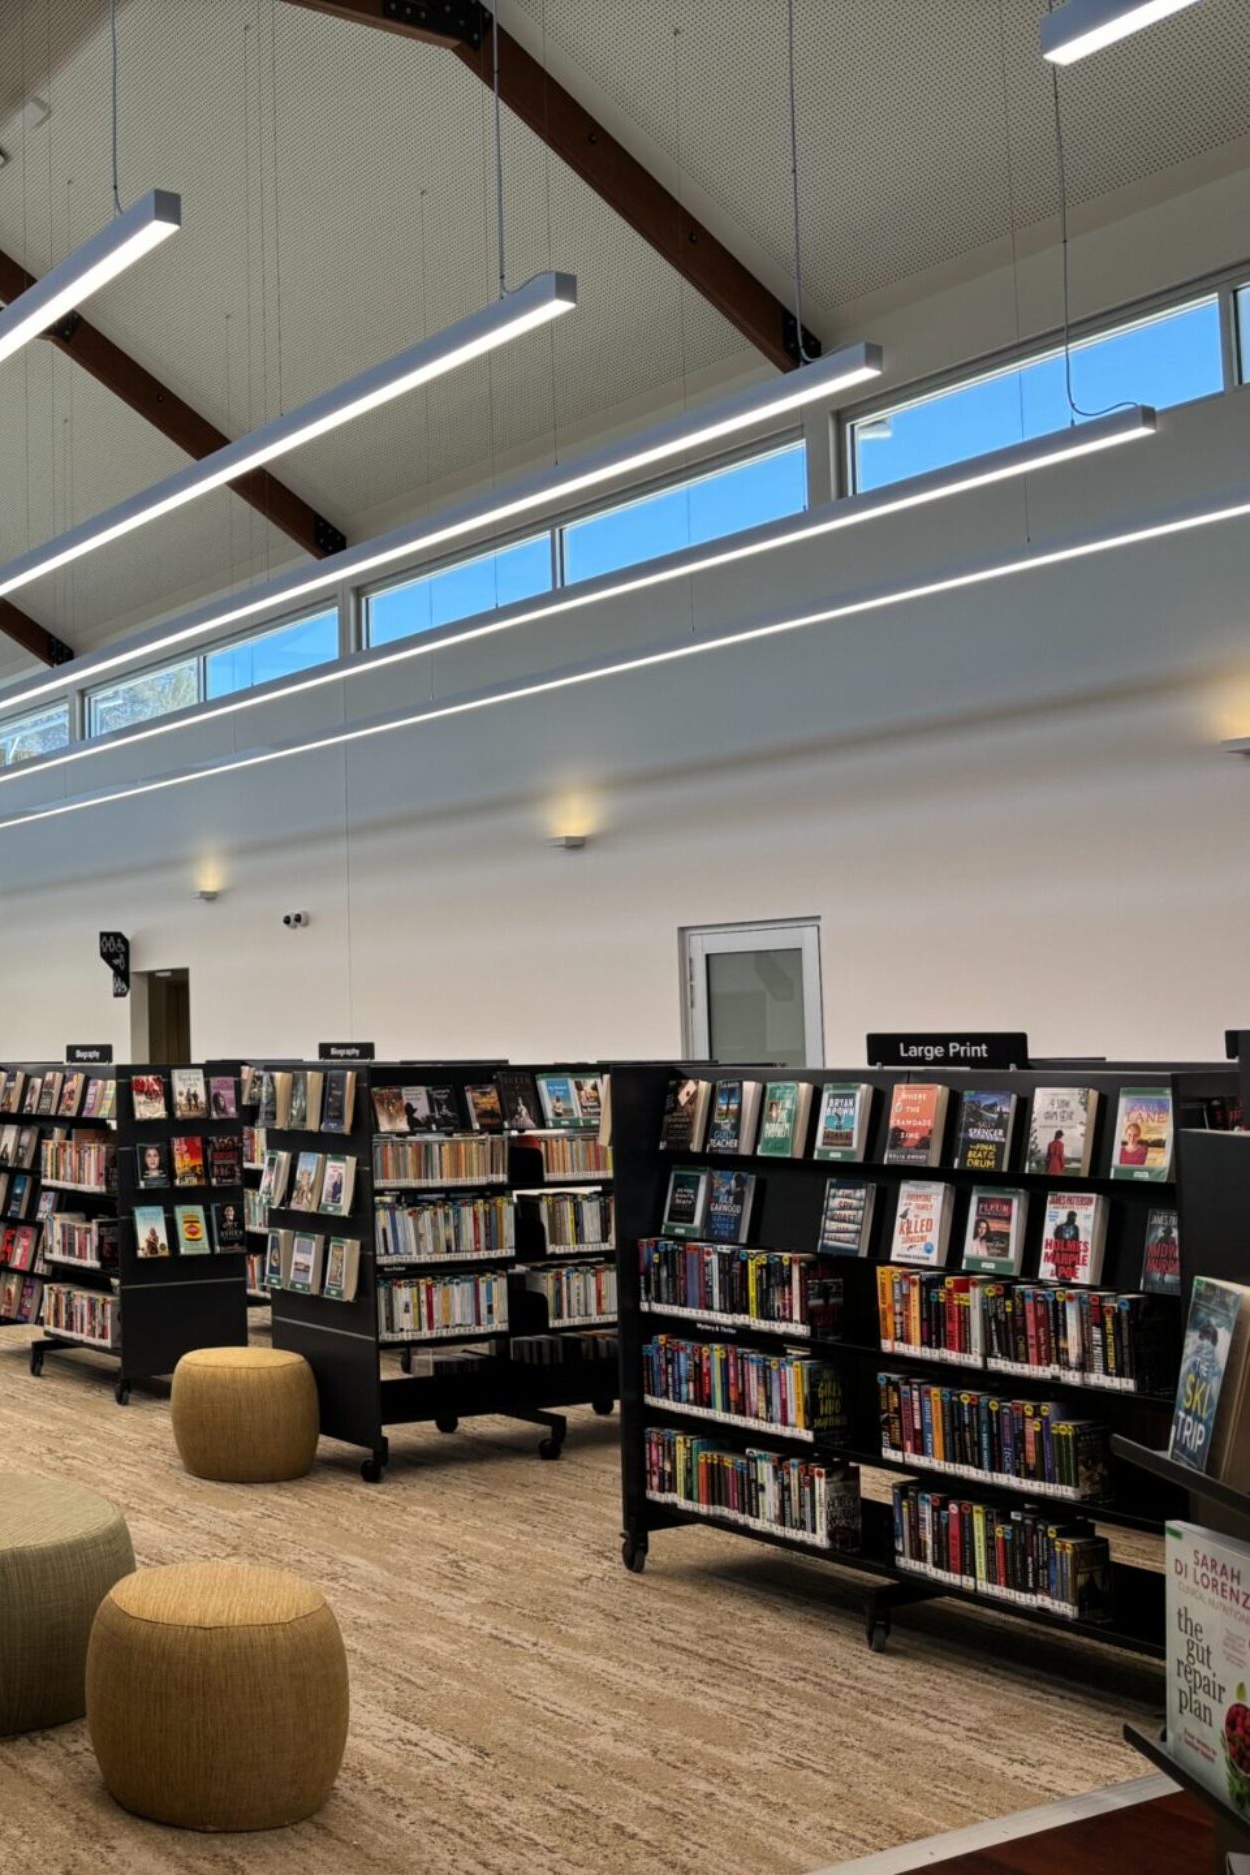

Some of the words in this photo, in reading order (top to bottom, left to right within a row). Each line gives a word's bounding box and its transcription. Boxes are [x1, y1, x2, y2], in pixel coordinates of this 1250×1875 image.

[900, 1042, 944, 1061] Large
[948, 1042, 988, 1058] Print
[828, 1098, 855, 1107] BRYAN
[968, 1128, 1004, 1137] SPENCER
[966, 1159, 996, 1168] DRUM
[899, 1218, 933, 1236] KILLED
[1045, 1238, 1089, 1253] HOLMES
[1043, 1252, 1088, 1267] MARPLE
[1057, 1266, 1079, 1279] POE
[1094, 1345, 1104, 1374] PATTERS
[1183, 1374, 1213, 1419] SKI
[1176, 1410, 1206, 1453] TRIP
[1174, 1558, 1188, 1578] DI
[1193, 1550, 1241, 1586] SARAH
[1177, 1606, 1203, 1642] the
[1186, 1639, 1212, 1670] gut
[1176, 1657, 1226, 1704] repair
[1177, 1685, 1213, 1727] plan
